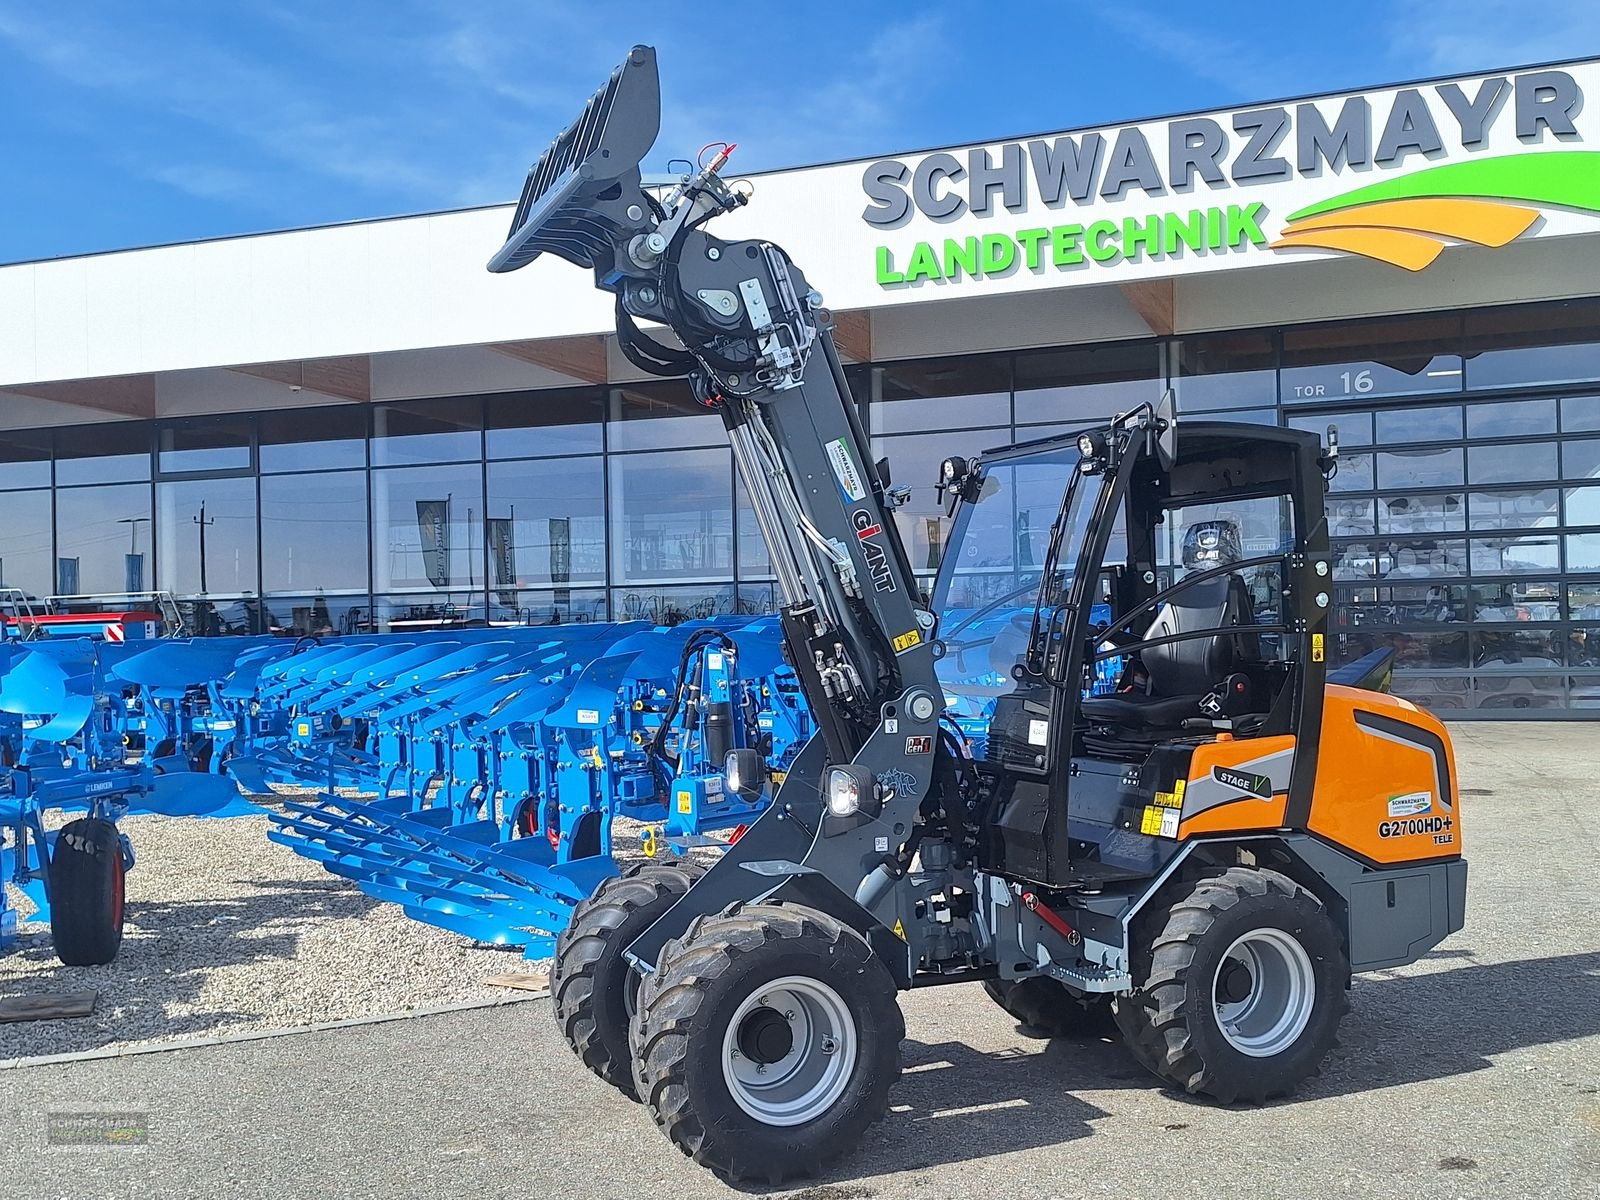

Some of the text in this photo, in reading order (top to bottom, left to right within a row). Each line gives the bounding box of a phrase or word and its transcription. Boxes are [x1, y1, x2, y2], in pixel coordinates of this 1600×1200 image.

[863, 69, 1582, 226] SCHWARZMAYR
[876, 202, 1267, 286] LANDTECHNIK
[1294, 370, 1374, 397] TOR 16
[837, 444, 858, 491] SCHWARZMAYR
[851, 508, 897, 593] GIANT
[1220, 771, 1251, 790] STAGE
[1378, 815, 1453, 838] G2700HD+
[1433, 834, 1453, 845] TELE
